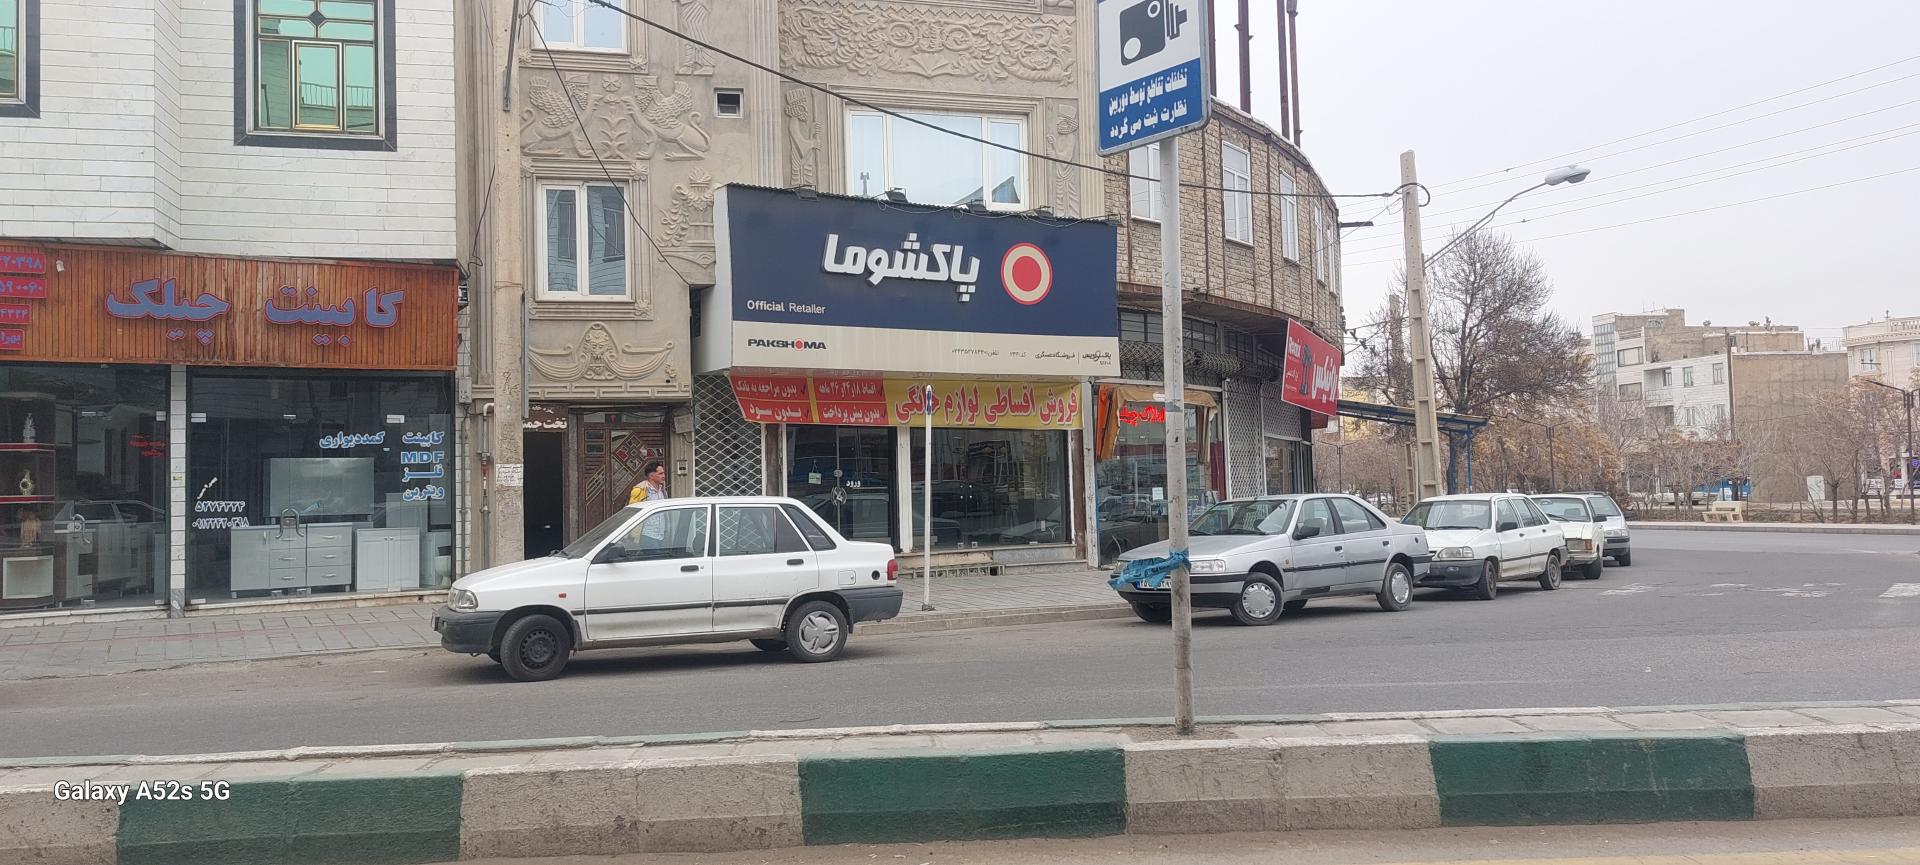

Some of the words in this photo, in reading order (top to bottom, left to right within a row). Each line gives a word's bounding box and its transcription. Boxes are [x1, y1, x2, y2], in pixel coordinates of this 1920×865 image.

[1165, 67, 1188, 93] تخلفات
[1129, 81, 1146, 106] توسط
[1147, 76, 1164, 104] تقاطع
[1109, 92, 1128, 116] دوربین
[1160, 99, 1188, 123] نظارت
[1130, 118, 1142, 135] می
[1143, 107, 1158, 128] ثبت
[1110, 117, 1128, 139] گردد
[822, 232, 980, 302] پاکشوما
[105, 277, 232, 346] چیلک
[264, 285, 405, 346] کابینت
[746, 299, 785, 312] Official
[788, 302, 826, 314] Retailer
[747, 338, 827, 351] PAKSHOMA
[735, 380, 750, 396] بانک
[758, 380, 780, 398] مراجعه
[781, 383, 797, 398] بدون
[749, 403, 773, 419] سود
[774, 405, 803, 422] بدون
[822, 403, 849, 424] پرداخت
[944, 384, 980, 425] لوازم
[983, 385, 1036, 425] اقساطی
[1039, 385, 1079, 424] فروش
[542, 417, 568, 429] تخت
[864, 408, 880, 423] بدون
[402, 430, 445, 447] کابینت
[400, 451, 445, 464] MDF
[401, 464, 444, 483] فلز
[402, 484, 445, 502] ویترین
[845, 479, 861, 488] ورود
